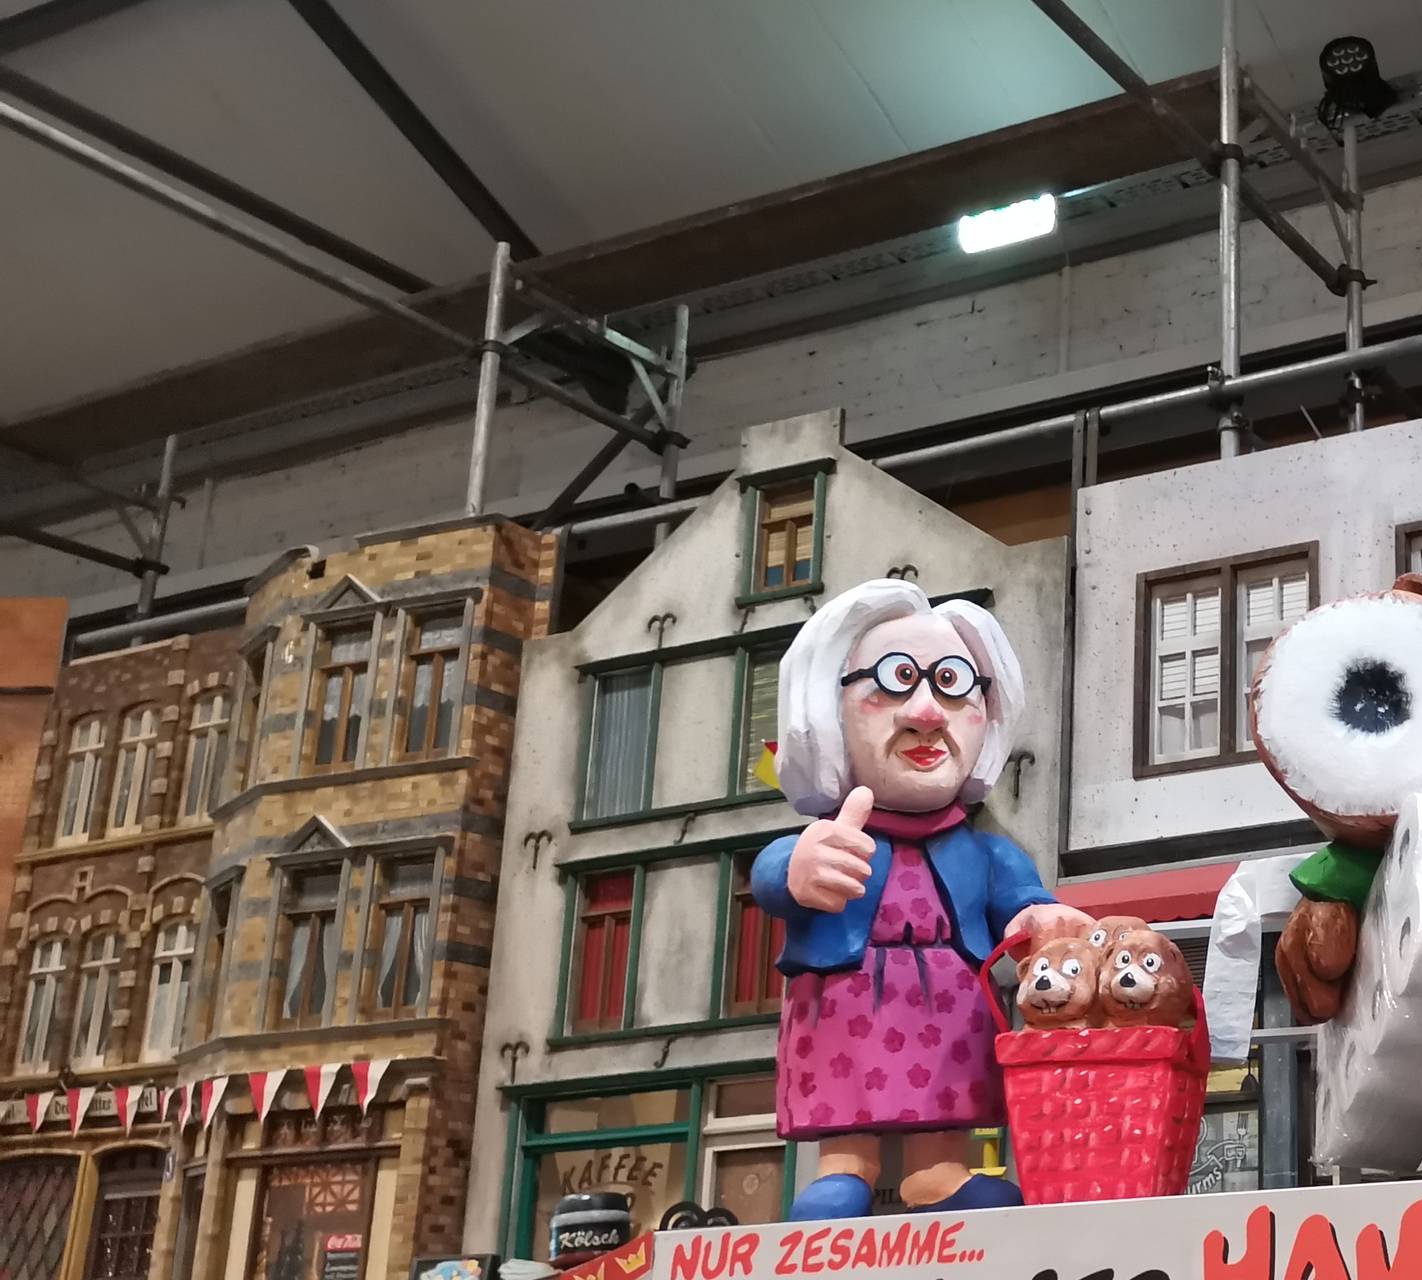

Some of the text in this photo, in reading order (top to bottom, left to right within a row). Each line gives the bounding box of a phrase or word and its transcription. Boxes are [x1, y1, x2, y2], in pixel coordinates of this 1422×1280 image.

[562, 1152, 663, 1195] KAFFEE
[559, 1228, 620, 1250] Kölsch
[670, 1220, 985, 1280] NUR ZESAMME...
